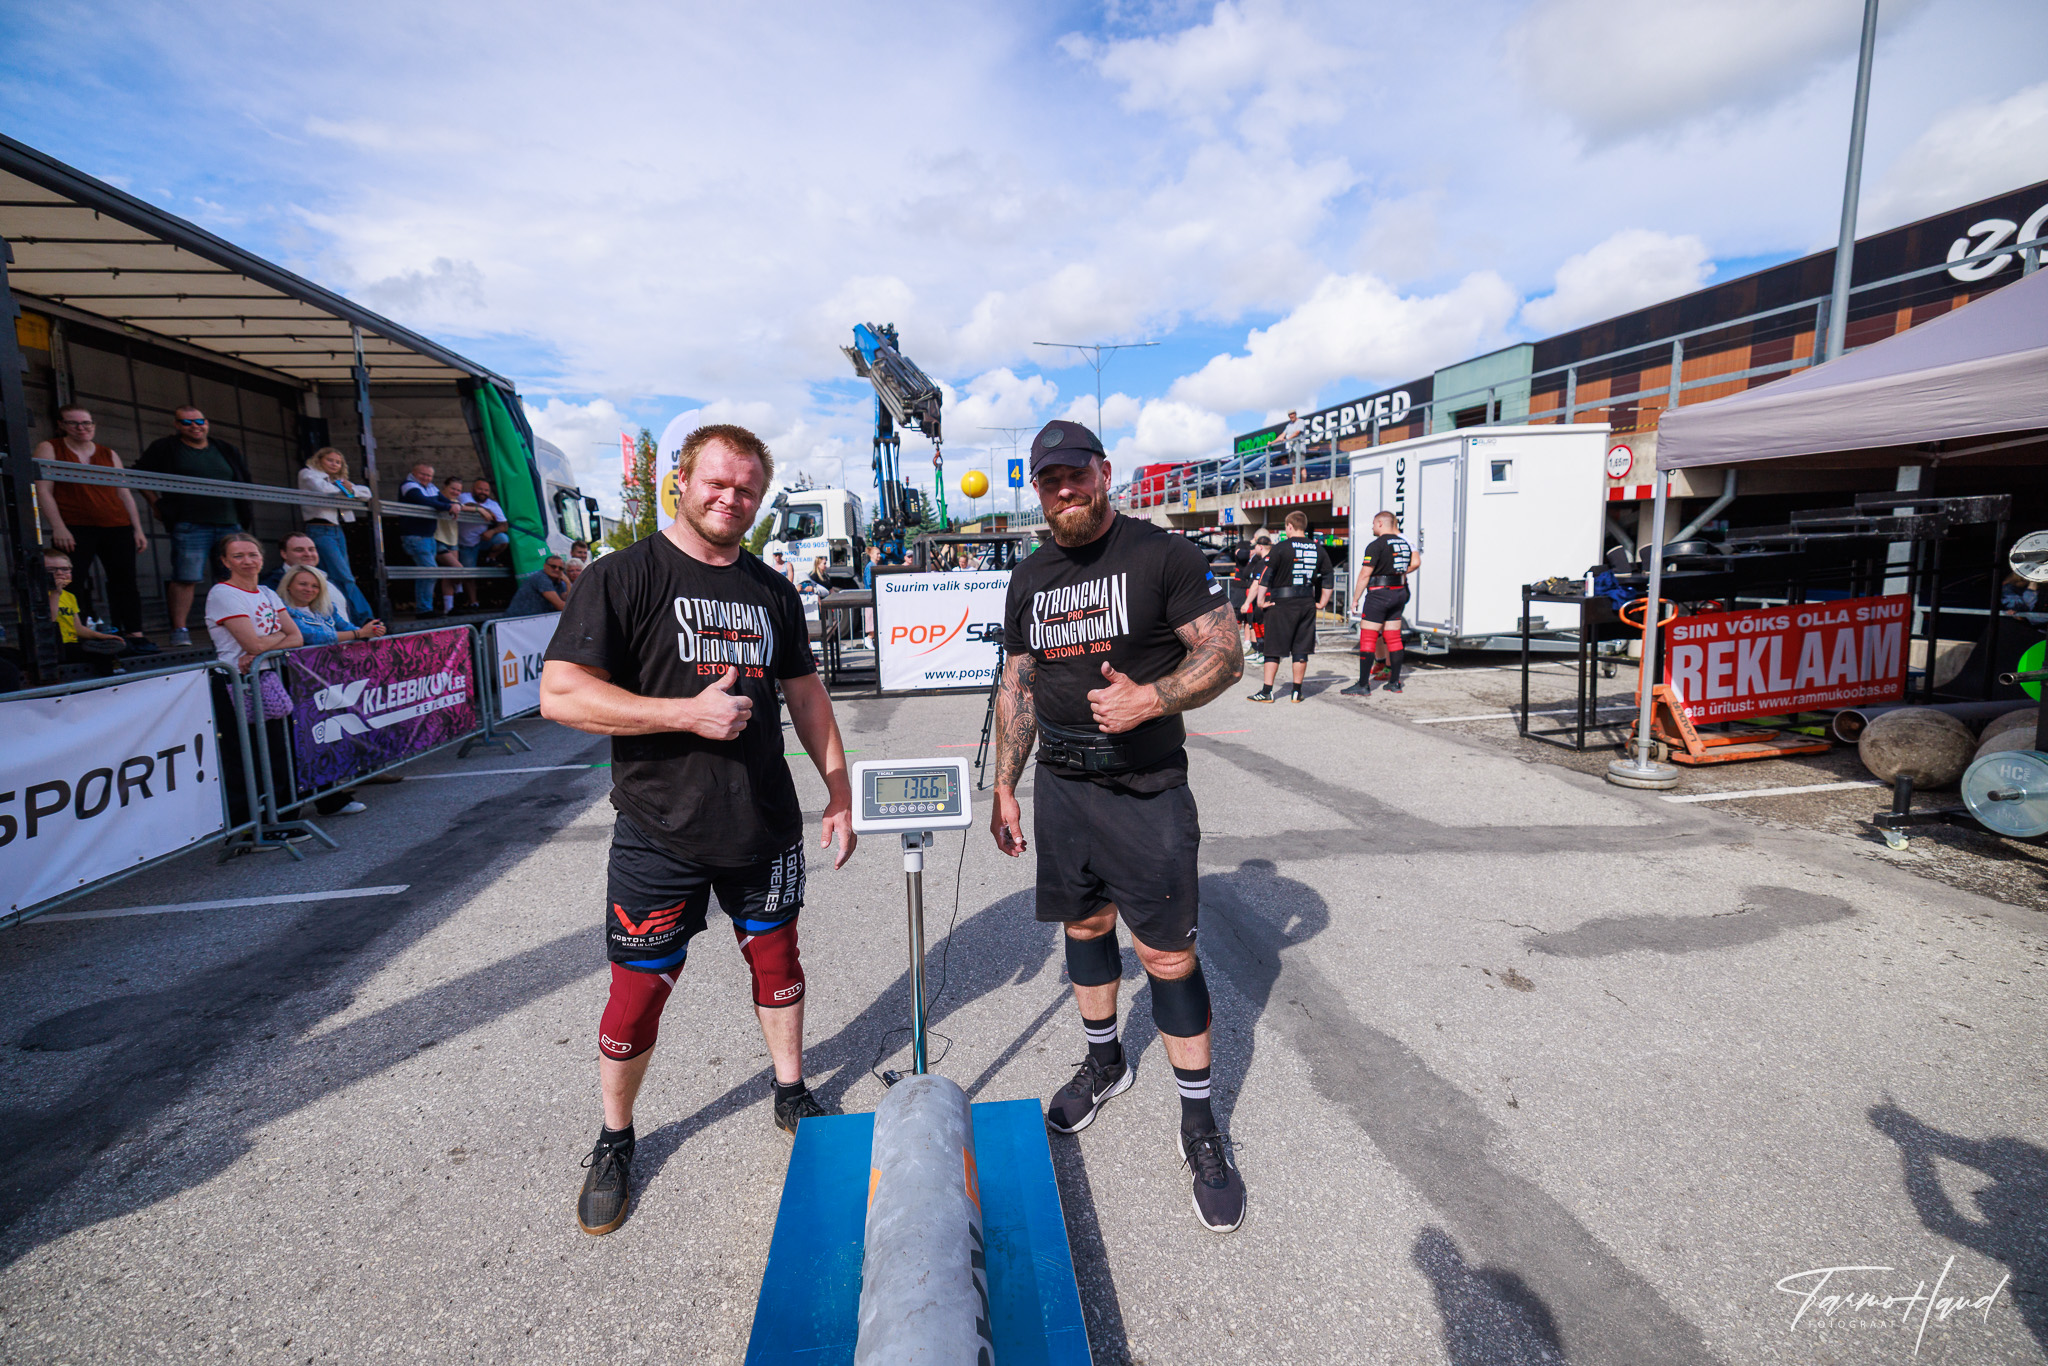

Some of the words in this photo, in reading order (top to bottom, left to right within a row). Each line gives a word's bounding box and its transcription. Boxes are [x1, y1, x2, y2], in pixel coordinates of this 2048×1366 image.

[1286, 390, 1411, 449] ESERVED
[1010, 465, 1021, 481] 4
[885, 581, 929, 593] Suurim
[932, 580, 961, 591] valik
[963, 578, 1009, 593] spordiv
[1031, 572, 1129, 632] STRONGMAN
[674, 596, 774, 645] STRONGMAN
[1029, 598, 1129, 650] STRONGWOMAN
[1067, 609, 1084, 622] PRO
[1672, 622, 1718, 641] SIIN
[1725, 614, 1791, 636] VÕIKS
[1796, 609, 1850, 628] OLLA
[1855, 603, 1904, 622] SINU
[723, 629, 739, 641] PRO
[890, 624, 947, 645] POP
[1043, 644, 1086, 660] ESTONIA
[1089, 640, 1112, 654] 2026
[696, 664, 740, 677] ESTONA
[1671, 622, 1903, 703] REKLAAM
[1708, 698, 1756, 716] üritust:
[1758, 683, 1898, 710] www.rammukoobas.ee
[2001, 764, 2024, 781] HC
[903, 776, 939, 799] 136.6
[764, 853, 783, 912] TREMES
[782, 853, 798, 904] GOING
[611, 933, 646, 943] VOSTOK
[648, 925, 686, 943] EUROPE
[774, 984, 802, 1000] SBD
